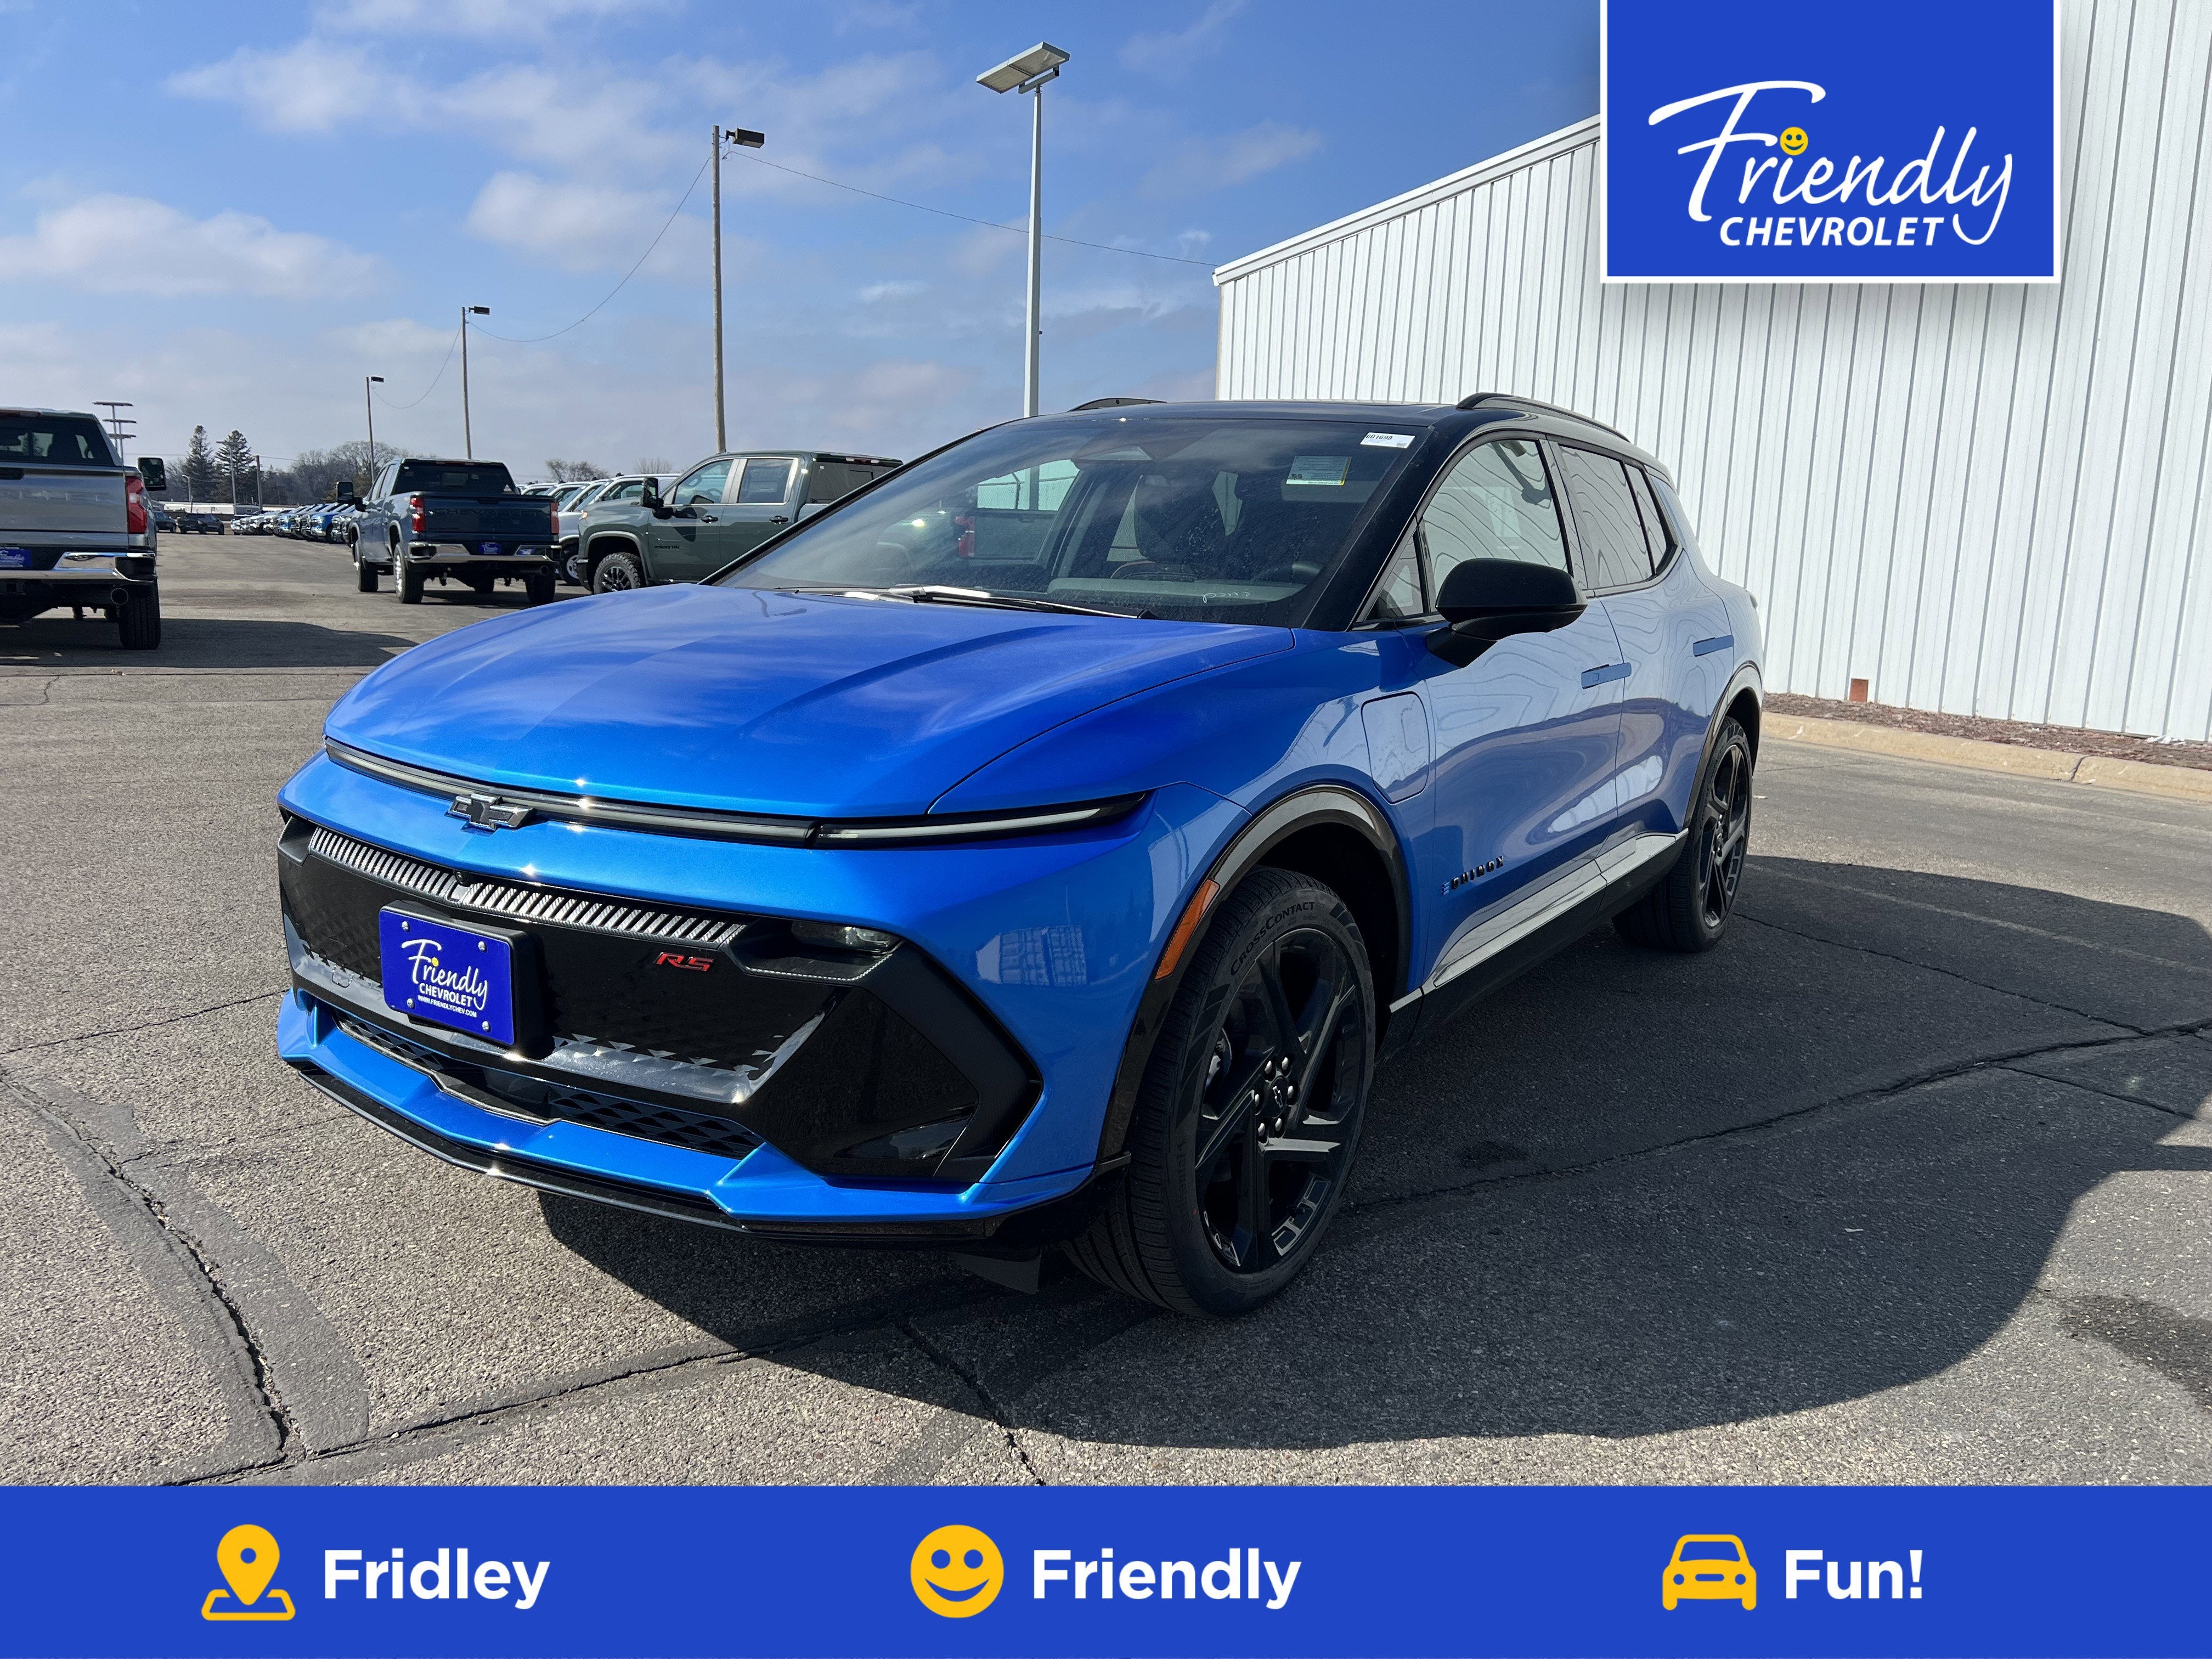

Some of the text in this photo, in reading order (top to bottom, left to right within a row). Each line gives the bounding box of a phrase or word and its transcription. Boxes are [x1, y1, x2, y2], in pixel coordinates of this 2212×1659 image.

[1441, 856, 1504, 896] EQUINOX
[653, 952, 715, 972] RS
[401, 939, 488, 1011] Friendly
[417, 995, 477, 1018] WWW.FRIENDLYCHEV.COM
[419, 983, 474, 1008] CHEVROLET
